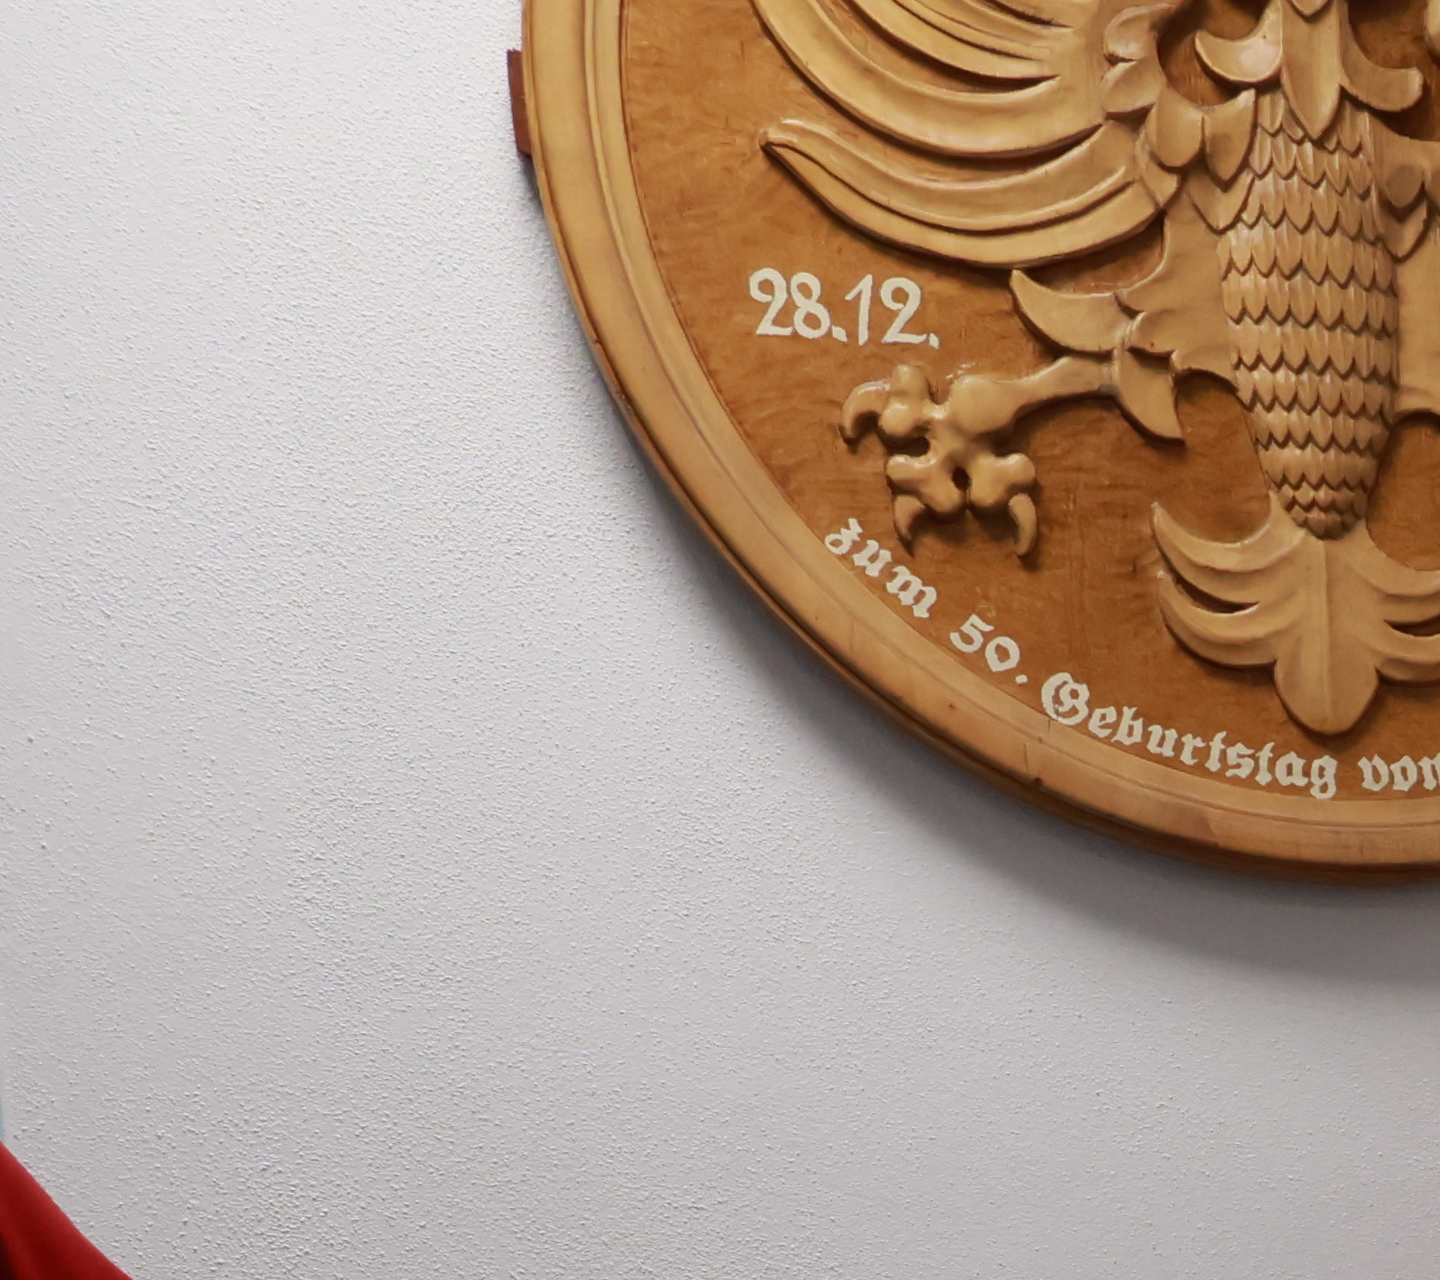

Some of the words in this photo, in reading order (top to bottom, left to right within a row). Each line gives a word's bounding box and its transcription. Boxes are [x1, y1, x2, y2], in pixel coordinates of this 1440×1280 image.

[747, 265, 941, 351] 28.12.
[949, 612, 1029, 684] 50.
[1039, 670, 1340, 801] Geburtstag
